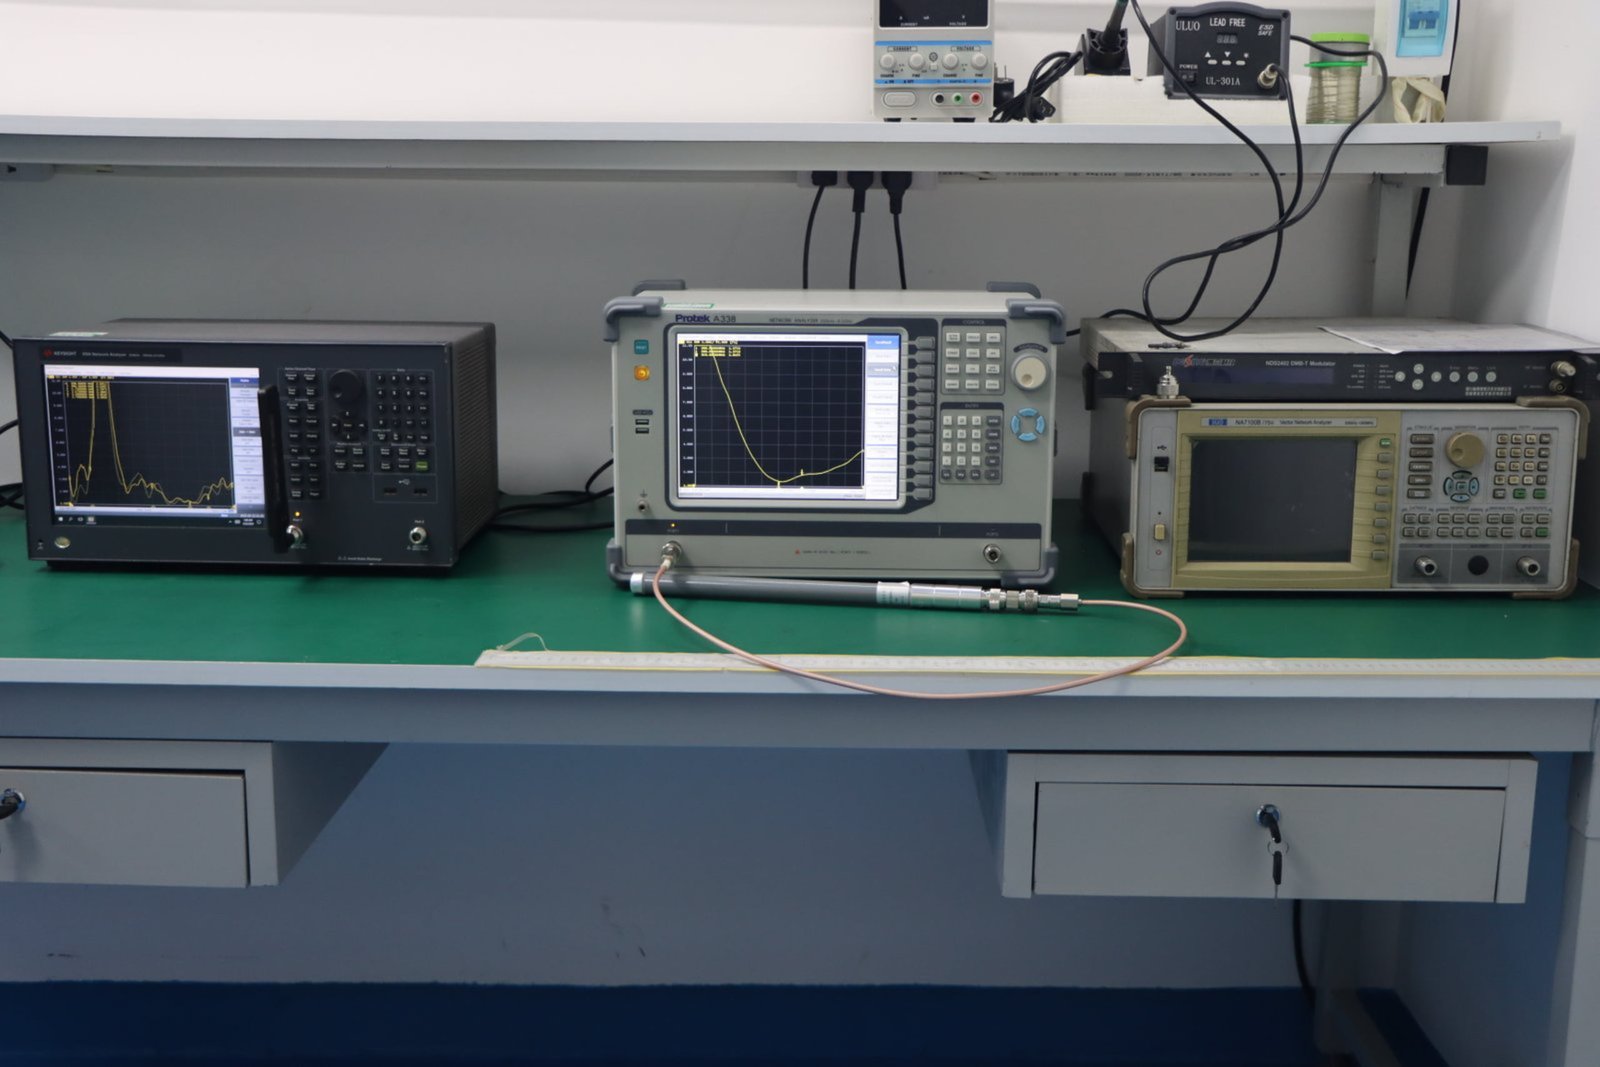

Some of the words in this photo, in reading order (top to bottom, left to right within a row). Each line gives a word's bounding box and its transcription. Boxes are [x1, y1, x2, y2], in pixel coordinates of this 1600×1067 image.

[1175, 20, 1200, 31] ULUO
[1209, 17, 1226, 27] LEAD
[1229, 18, 1246, 27] FREE
[1205, 77, 1241, 86] UL-301A
[675, 314, 711, 323] Protek
[713, 315, 737, 323] A338
